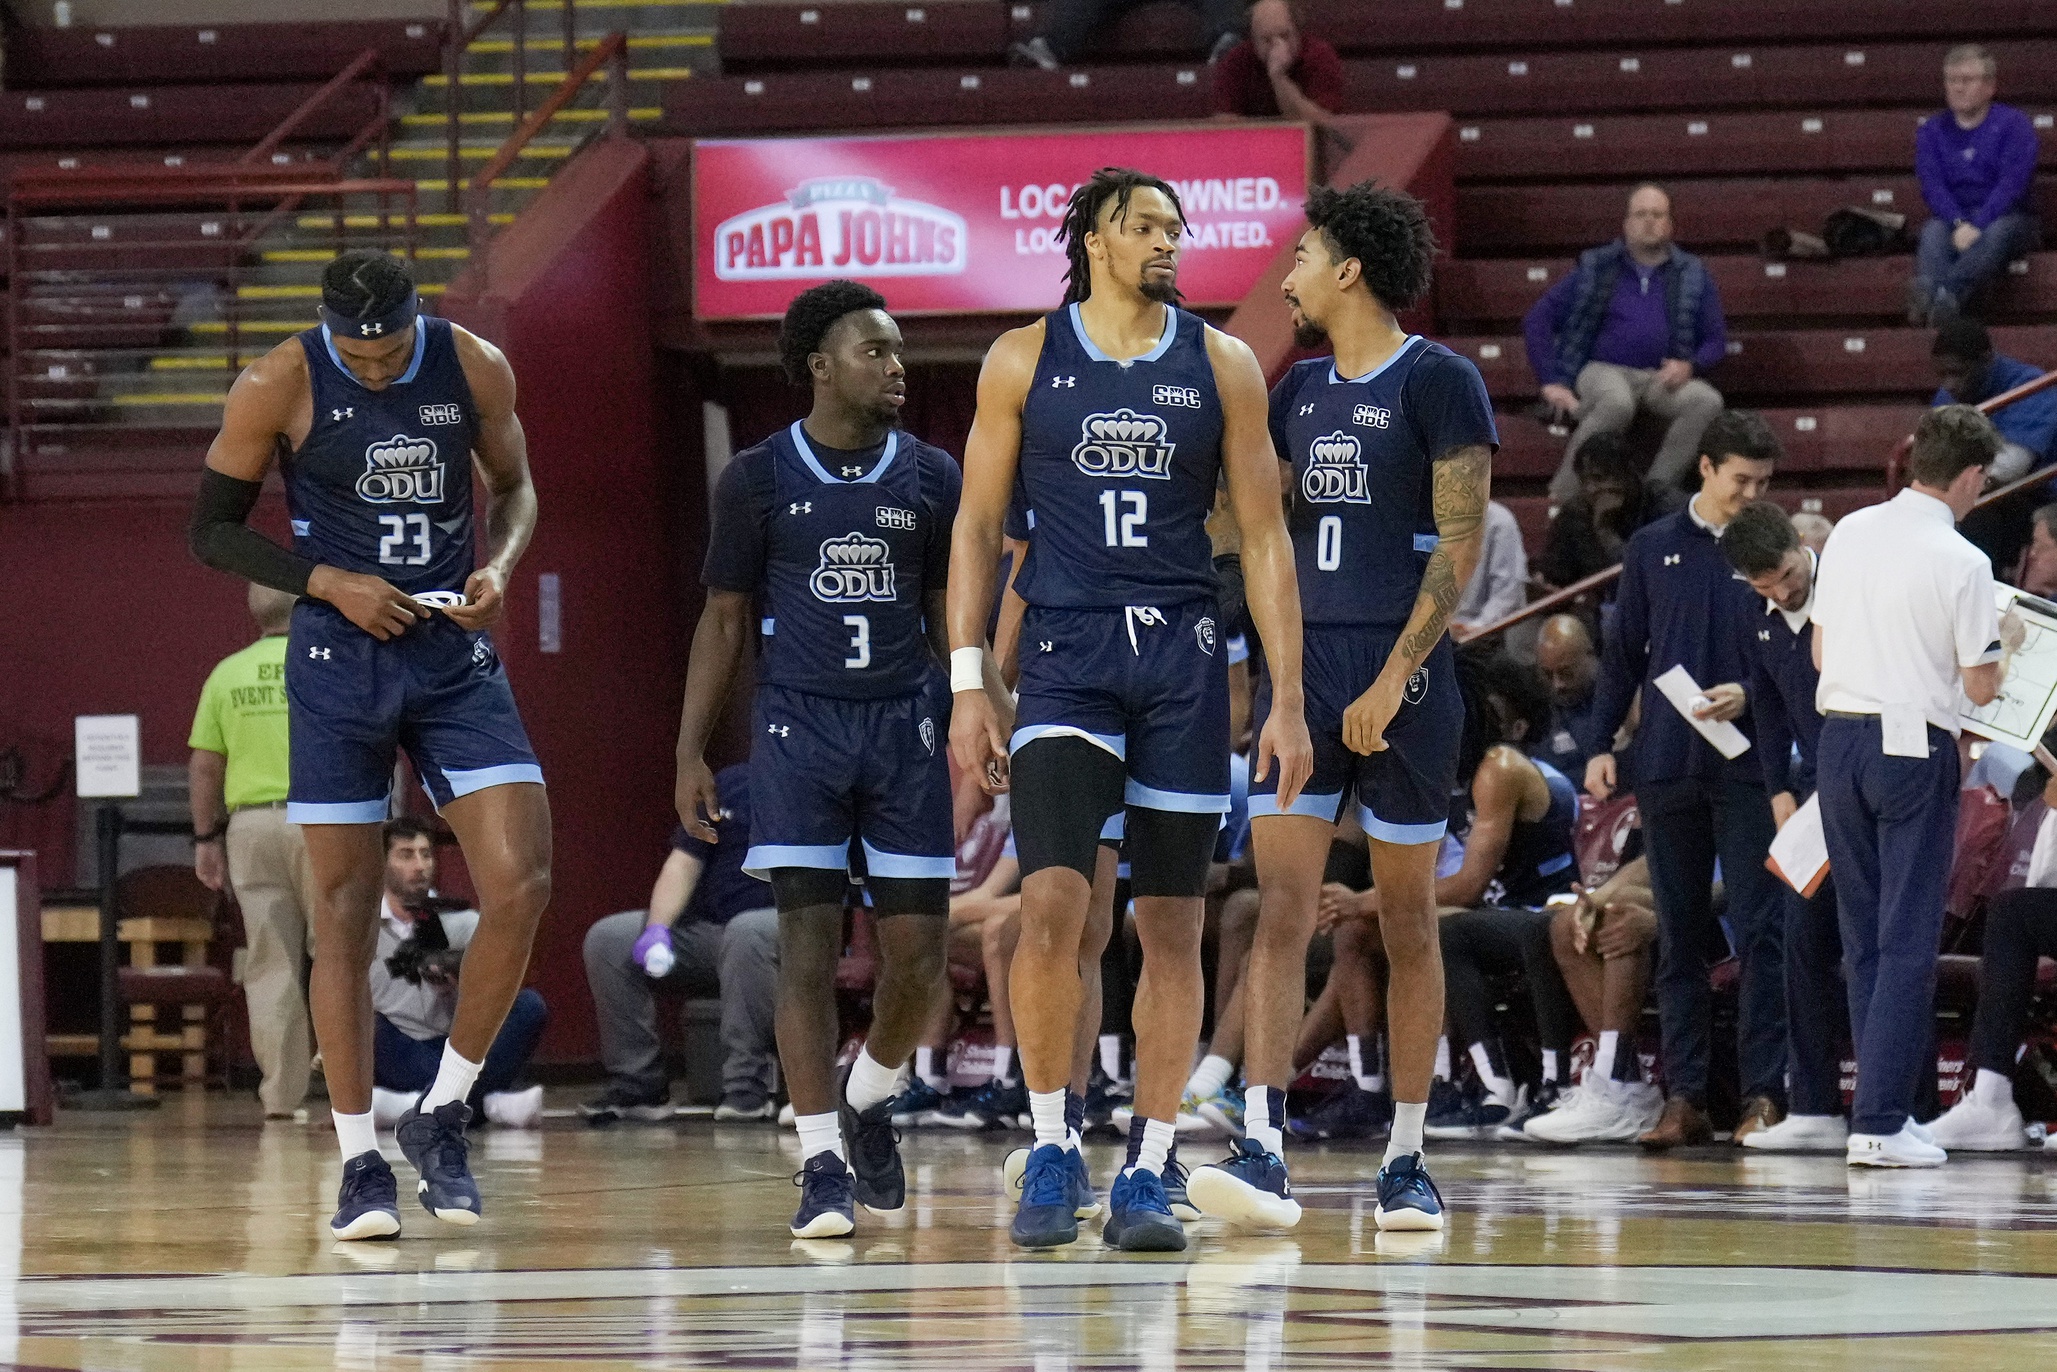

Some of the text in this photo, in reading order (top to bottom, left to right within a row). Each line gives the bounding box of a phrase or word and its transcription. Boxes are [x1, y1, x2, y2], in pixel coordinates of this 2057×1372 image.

[726, 211, 823, 269] PAPA
[1185, 221, 1273, 248] RATED.
[1152, 384, 1201, 409] SBC
[419, 403, 461, 426] SBC
[1352, 403, 1391, 429] SBC
[1075, 443, 1171, 477] ODU
[358, 468, 441, 502] ODU
[1304, 467, 1369, 500] ODU
[875, 506, 916, 531] SBC
[1099, 489, 1148, 547] 12
[378, 513, 432, 566] 23
[1317, 515, 1342, 572] 0
[813, 567, 895, 600] ODU
[843, 614, 870, 669] 3
